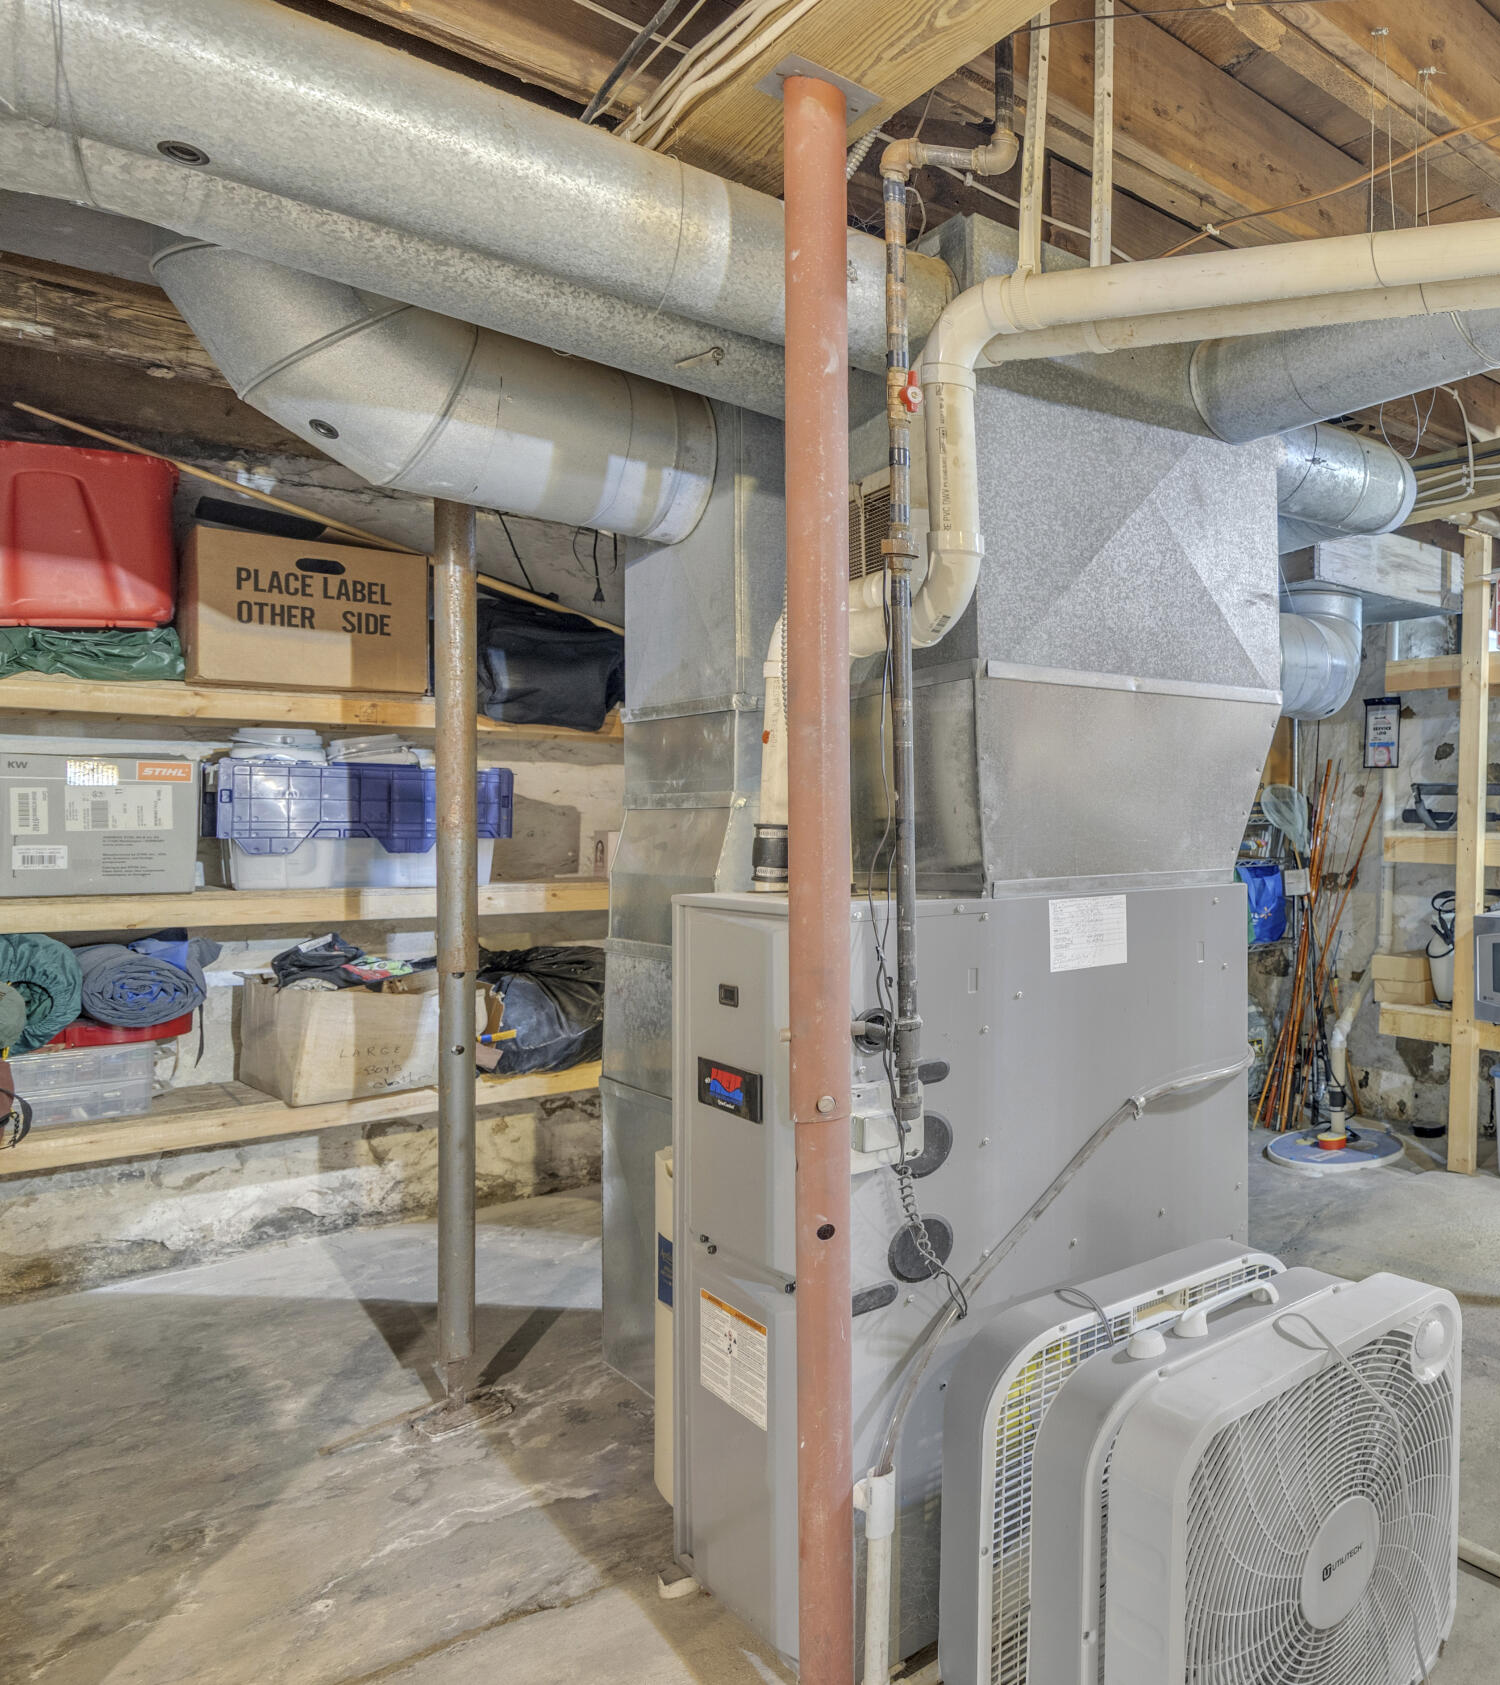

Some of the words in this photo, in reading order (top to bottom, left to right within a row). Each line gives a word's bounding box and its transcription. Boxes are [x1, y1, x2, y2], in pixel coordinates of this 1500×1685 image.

[236, 567, 314, 598] PLACE
[323, 577, 392, 606] LABEL
[237, 600, 315, 629] OTHER
[341, 611, 391, 636] SIDE
[7, 761, 28, 769] KW
[142, 767, 187, 777] STIHL
[338, 1046, 401, 1059] LARGE
[1331, 1543, 1362, 1571] UTILITECH
